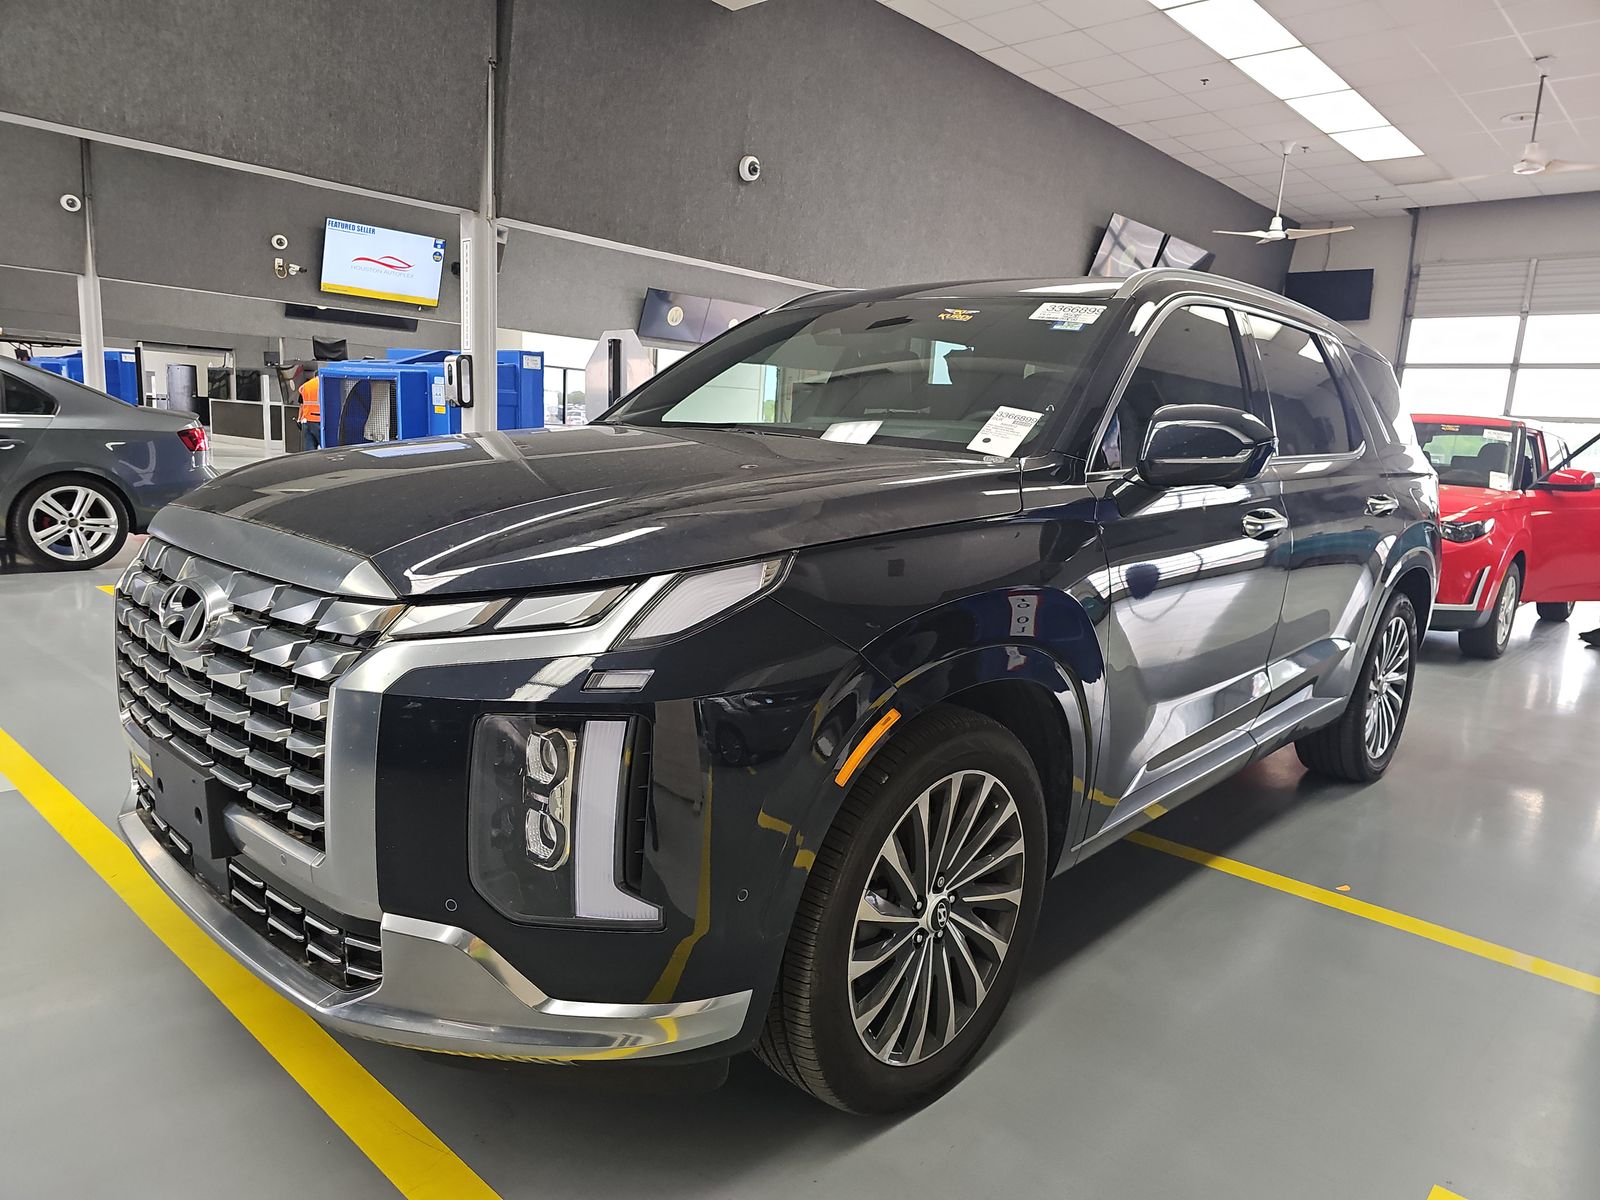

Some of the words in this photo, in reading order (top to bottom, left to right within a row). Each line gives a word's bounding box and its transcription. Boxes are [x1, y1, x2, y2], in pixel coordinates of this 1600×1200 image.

[327, 219, 356, 232] FEATURED
[356, 225, 376, 235] SELLER
[350, 264, 383, 275] HOUSTON
[1046, 304, 1106, 316] 3366899
[996, 410, 1039, 424] 3366899
